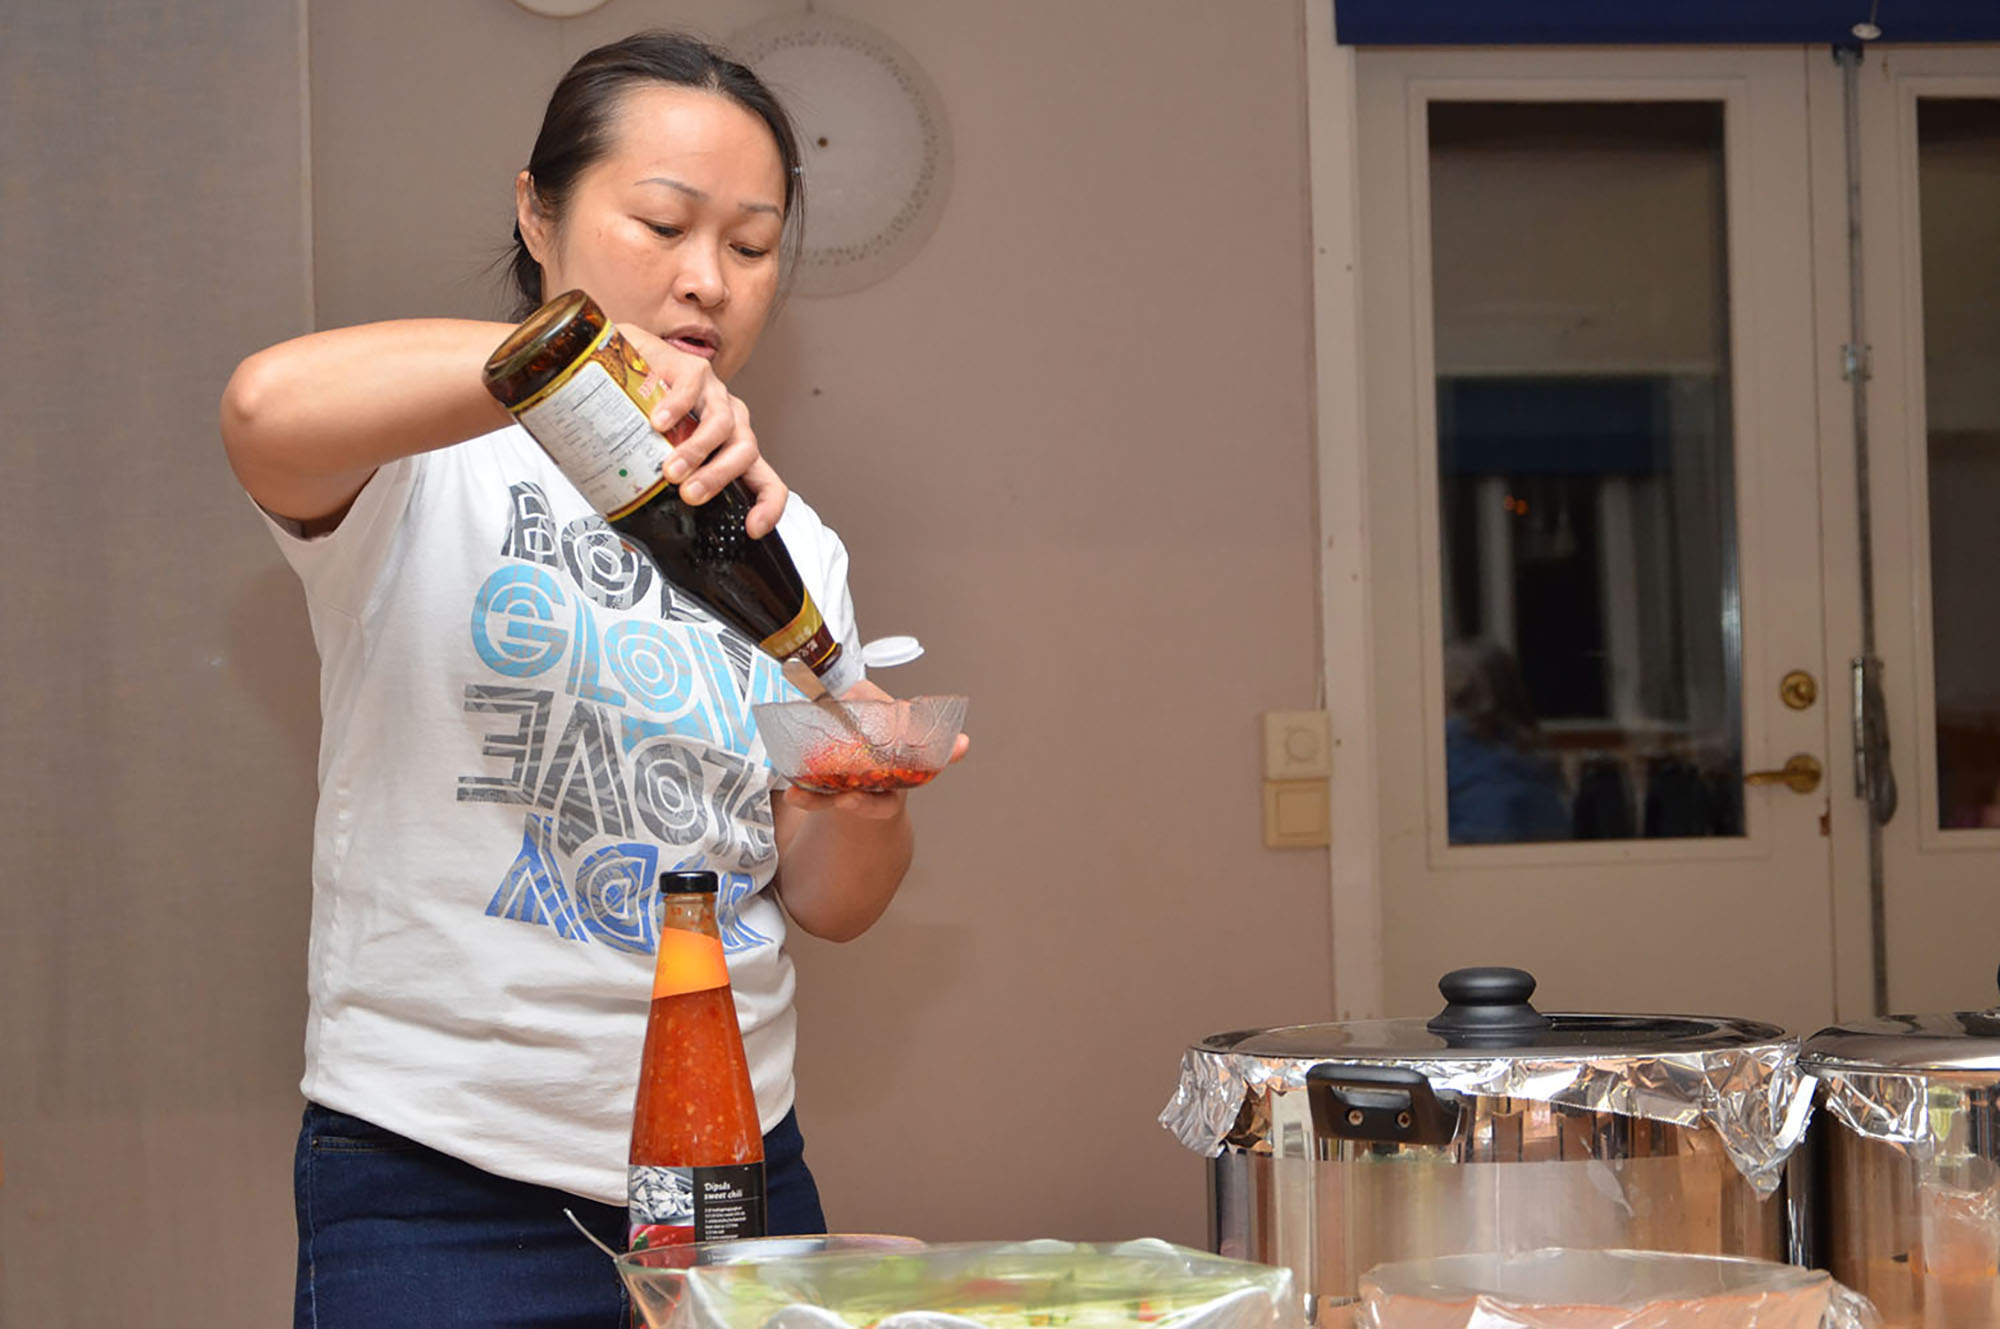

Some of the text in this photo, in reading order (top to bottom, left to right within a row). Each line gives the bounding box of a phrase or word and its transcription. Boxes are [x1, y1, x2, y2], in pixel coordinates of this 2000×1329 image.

[471, 564, 801, 769] GLOV
[500, 481, 758, 701] BO
[485, 812, 775, 956] BDY
[704, 1189, 743, 1200] sweet chili
